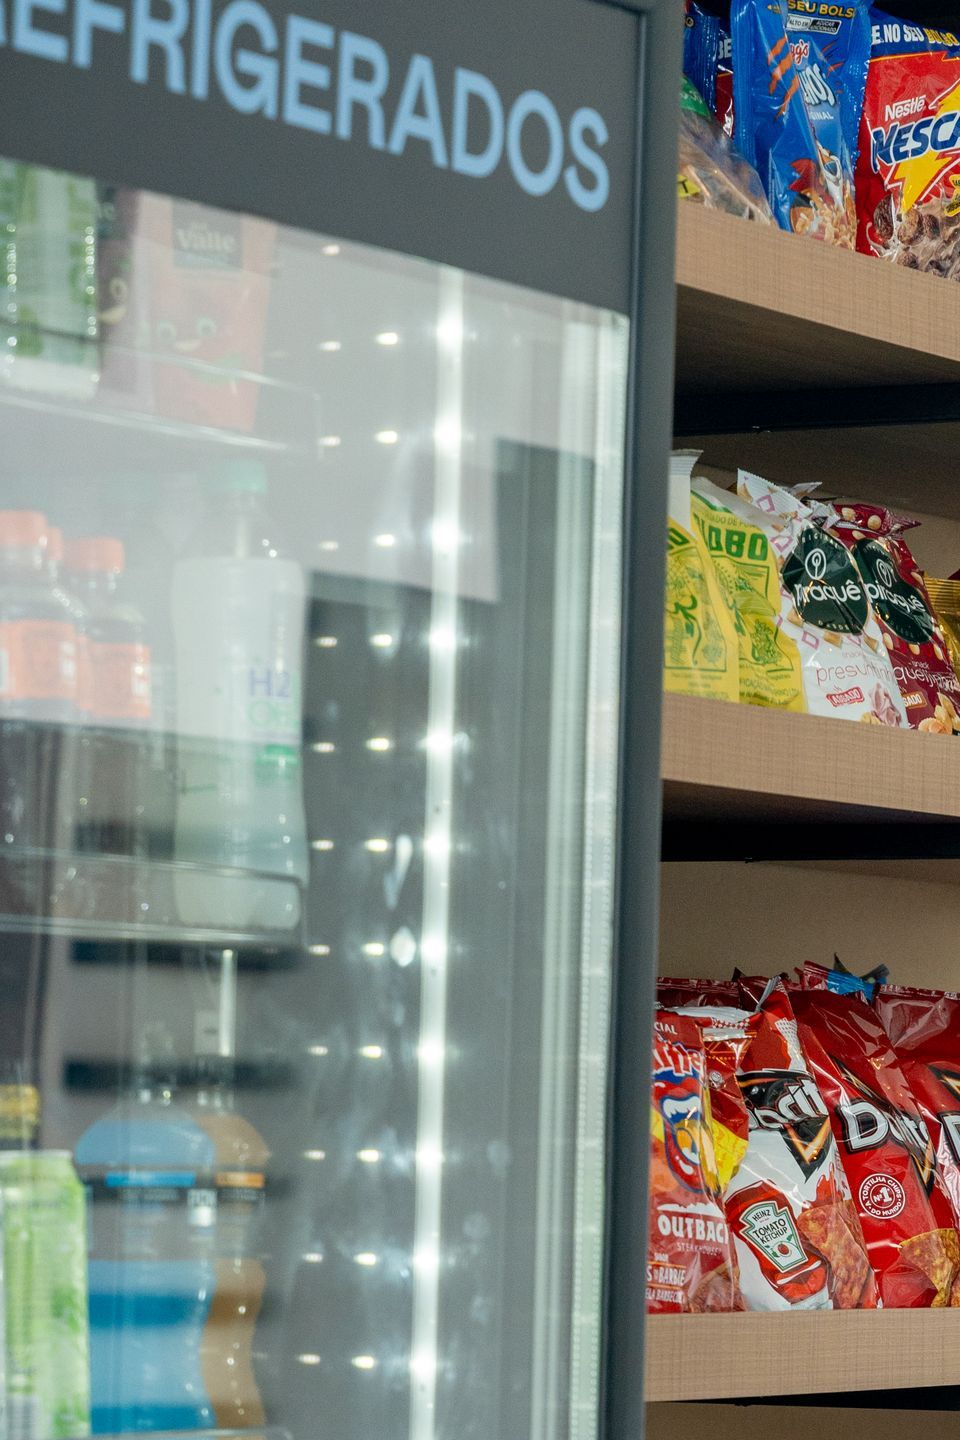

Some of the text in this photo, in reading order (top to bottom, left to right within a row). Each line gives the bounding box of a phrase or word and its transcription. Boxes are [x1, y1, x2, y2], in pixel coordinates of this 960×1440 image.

[819, 3, 855, 18] BOLS
[884, 24, 900, 42] NO
[0, 0, 611, 213] EFRIGERADOS
[885, 95, 926, 121] Nestlé
[816, 661, 894, 685] presuntinh
[653, 1022, 678, 1035] CIAL
[751, 1208, 771, 1223] HEINZ
[752, 1218, 786, 1238] TOMATO
[760, 1227, 788, 1245] KETCHUP
